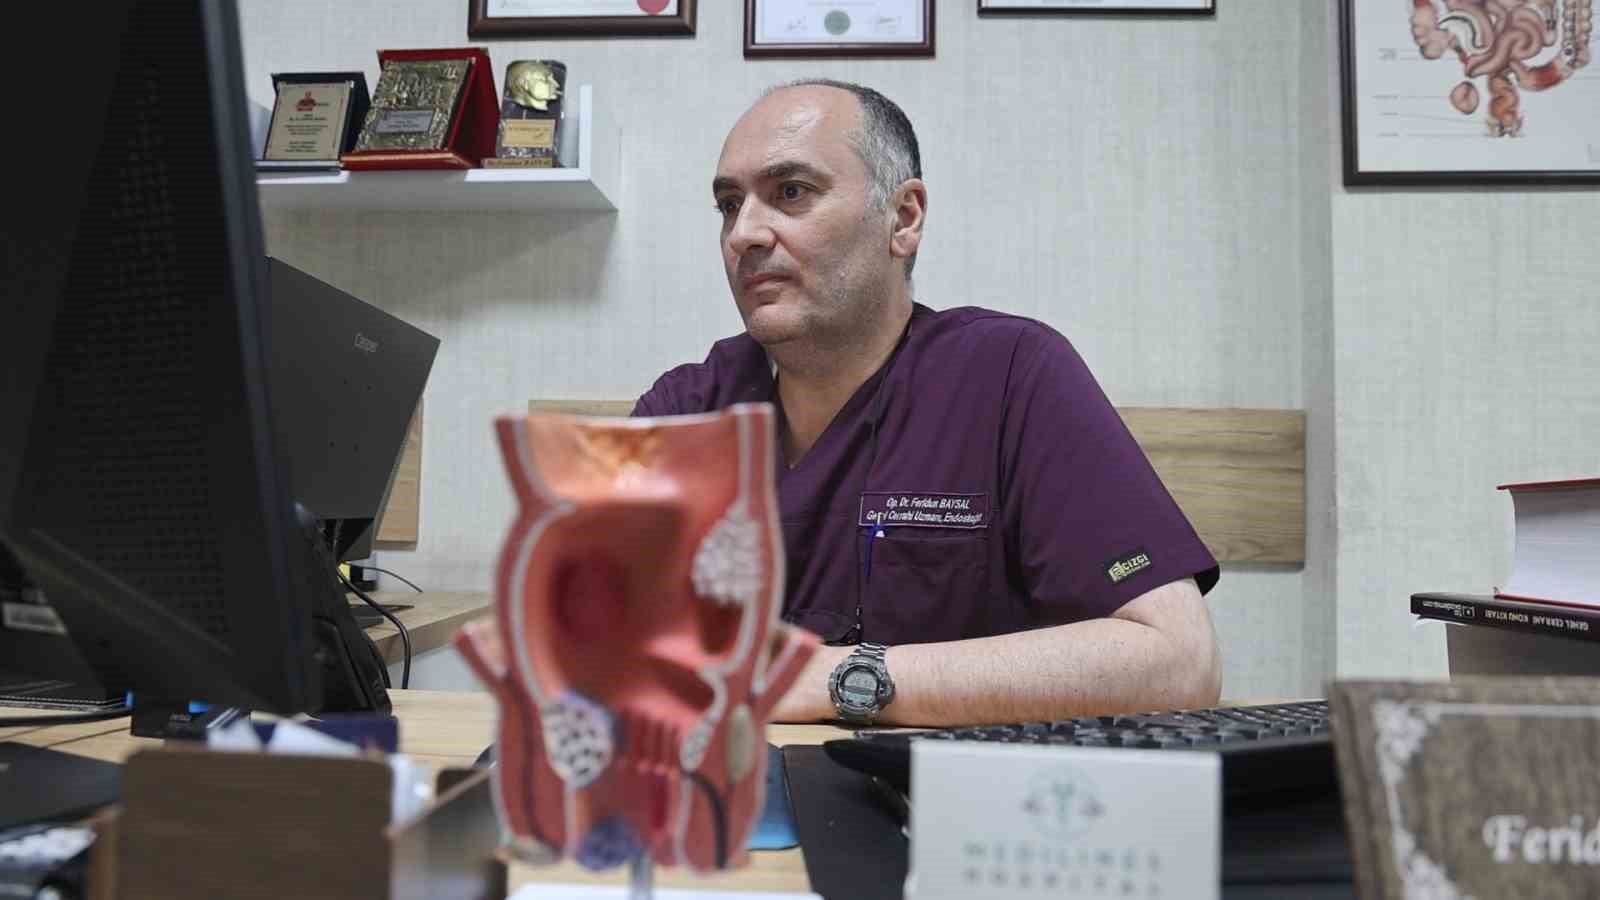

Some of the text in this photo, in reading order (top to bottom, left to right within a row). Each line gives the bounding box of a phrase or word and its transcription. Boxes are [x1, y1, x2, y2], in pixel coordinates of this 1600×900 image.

[910, 497, 938, 508] Feridun
[939, 498, 970, 509] BAYSAL
[1508, 612, 1529, 623] KONU
[1565, 619, 1589, 631] GENEL
